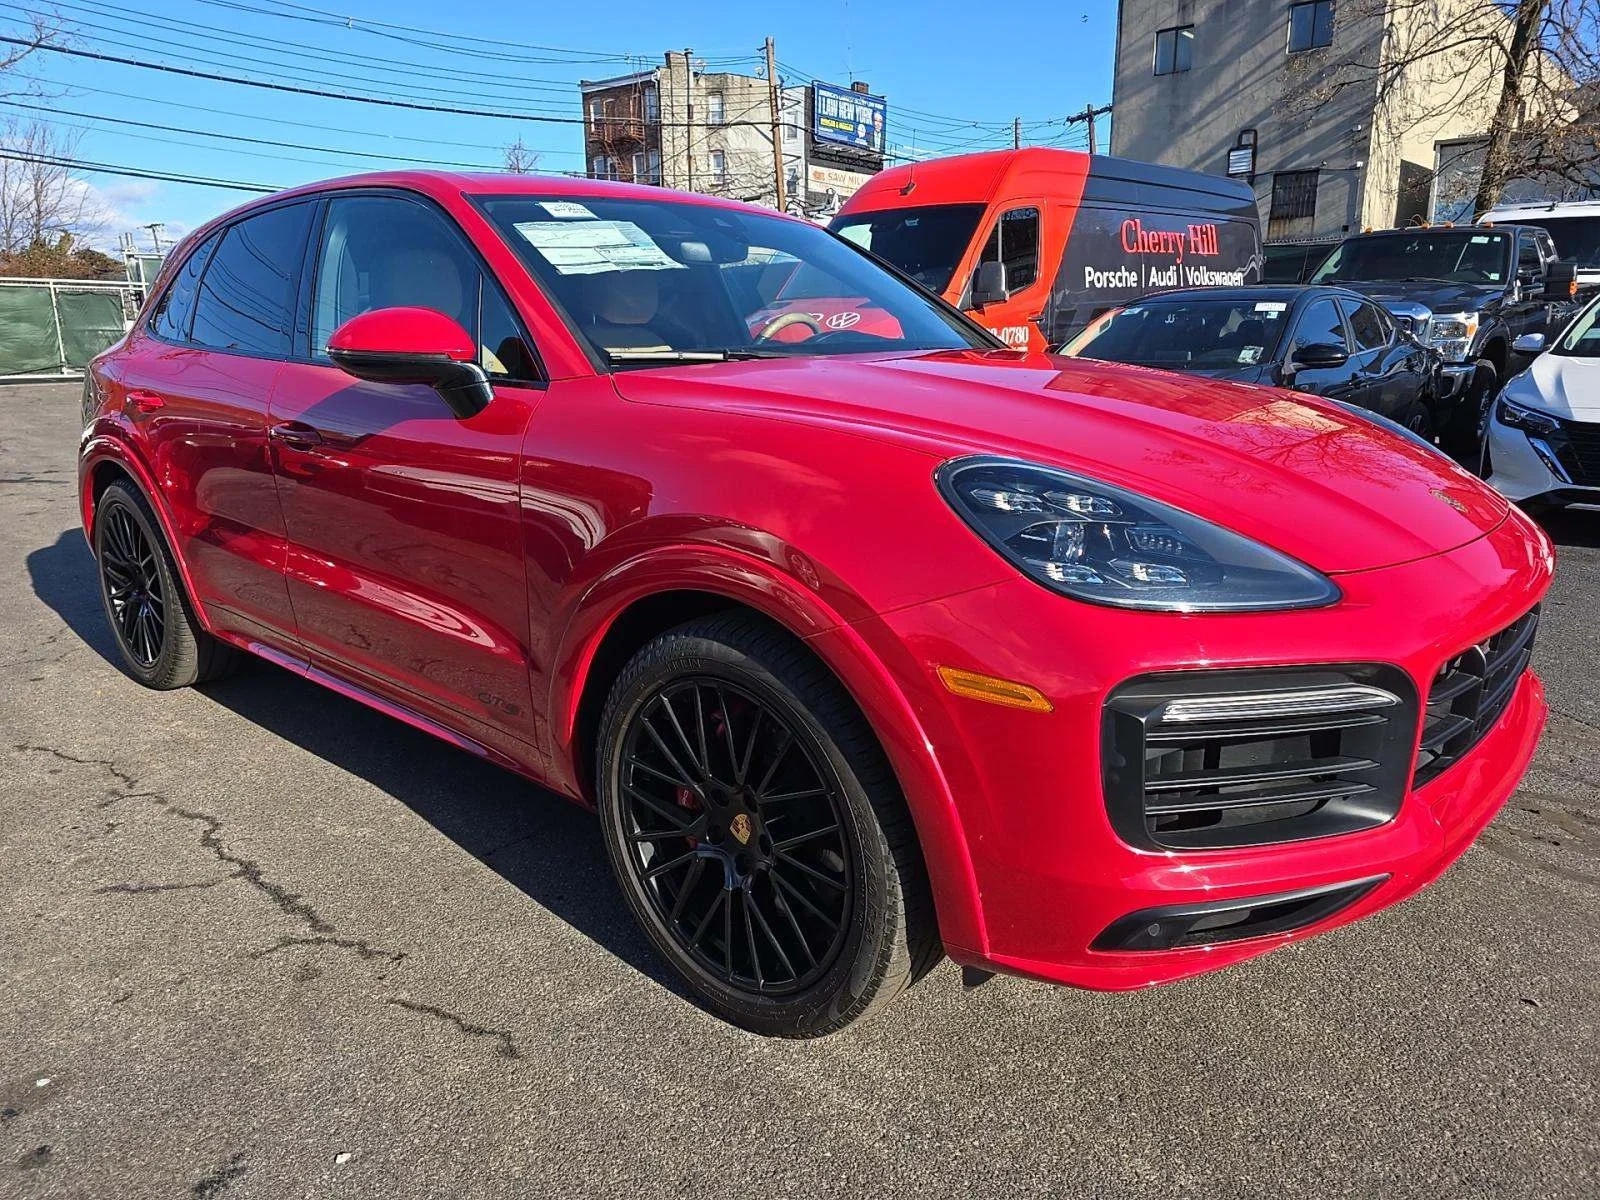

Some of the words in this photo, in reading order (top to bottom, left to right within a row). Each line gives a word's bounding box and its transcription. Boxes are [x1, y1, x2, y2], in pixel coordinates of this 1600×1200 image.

[822, 97, 838, 118] LAW
[839, 100, 855, 121] NEW
[855, 104, 873, 125] YORK
[828, 172, 846, 184] SAW
[1121, 218, 1185, 264] Cherry
[1186, 223, 1220, 256] Hill
[1085, 264, 1138, 288] Porsche
[1149, 265, 1177, 287] Audi
[1185, 265, 1244, 287] Volkswagen
